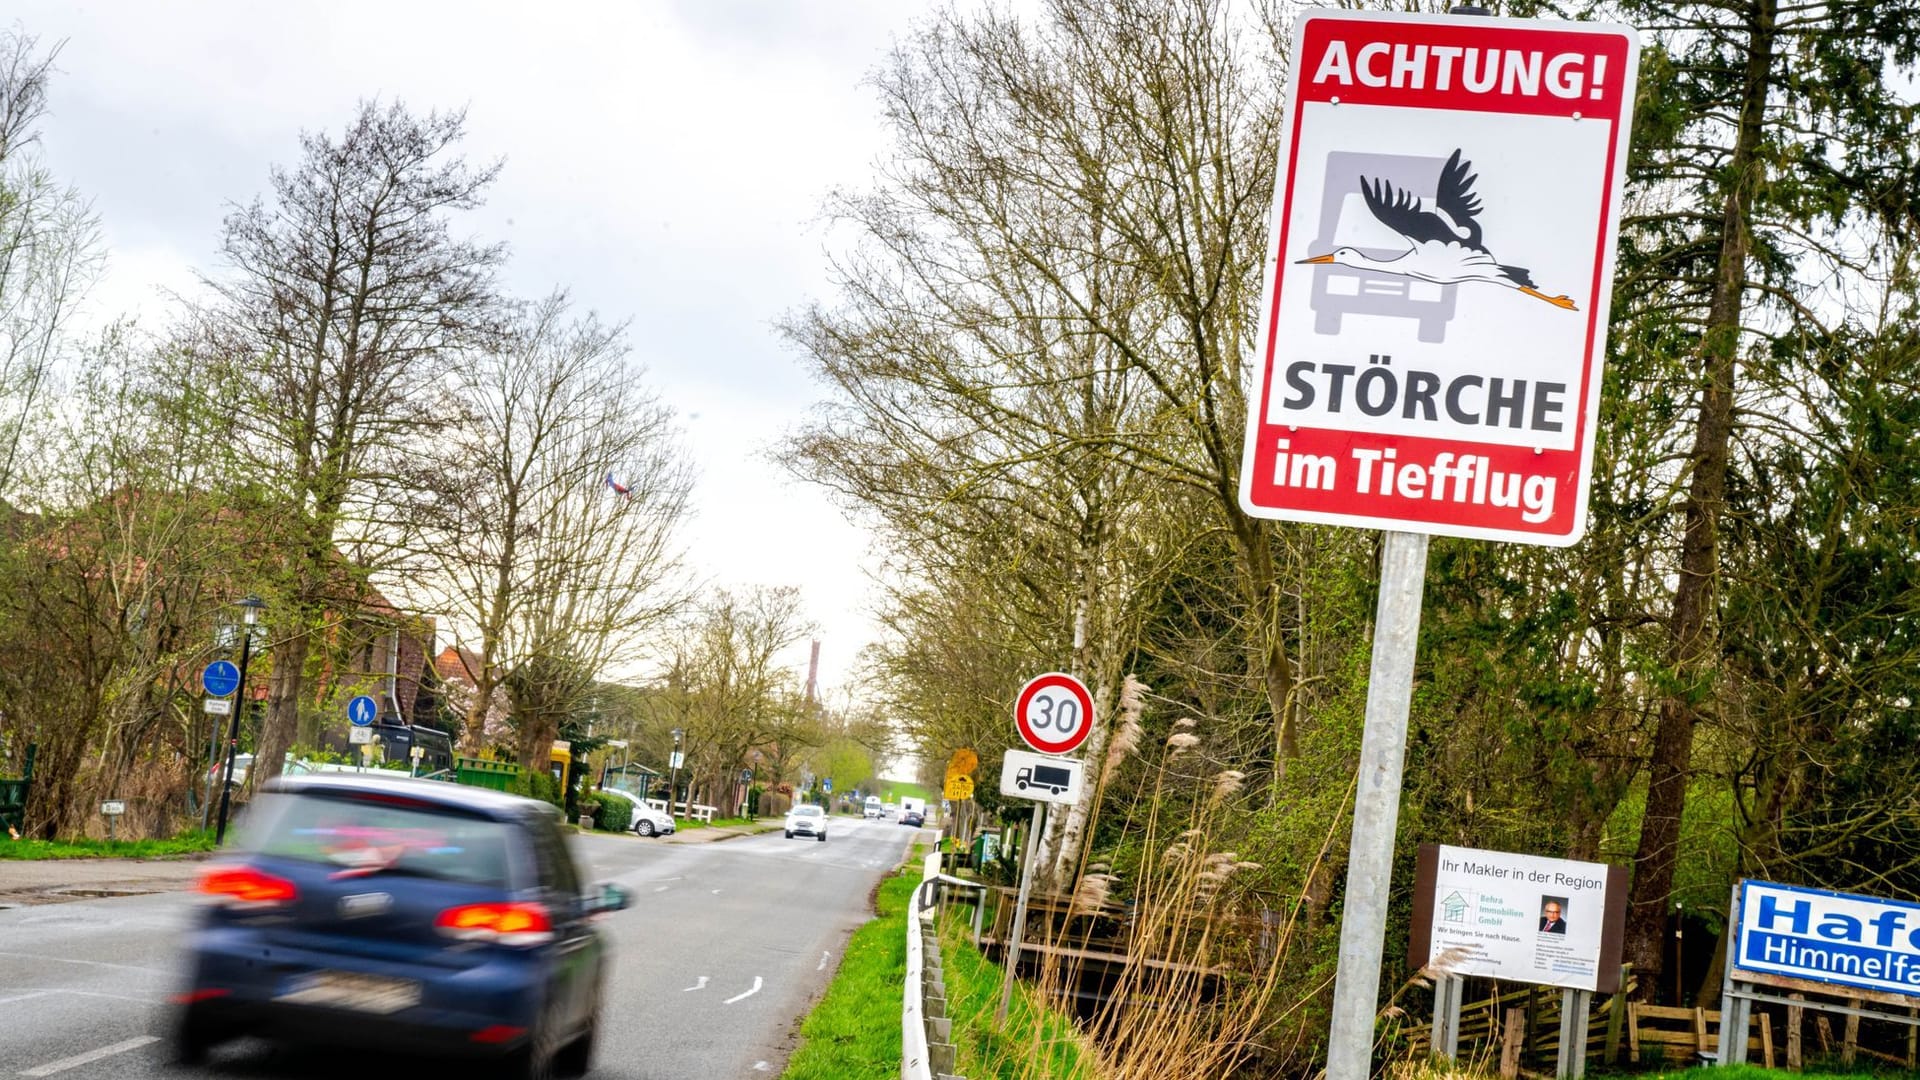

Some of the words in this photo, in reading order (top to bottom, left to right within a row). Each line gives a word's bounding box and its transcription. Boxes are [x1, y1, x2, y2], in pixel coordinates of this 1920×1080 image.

[1312, 40, 1608, 100] ACHTUNG!
[1282, 354, 1566, 432] STÖRCHE
[1272, 440, 1337, 491] im
[1353, 449, 1557, 523] Tiefflug
[1032, 695, 1077, 733] 30
[1441, 859, 1460, 873] Ihr
[1463, 862, 1509, 879] Makler
[1512, 867, 1524, 880] in
[1528, 870, 1551, 884] der
[1554, 873, 1602, 890] Region
[1478, 916, 1503, 926] GmbH
[1479, 906, 1524, 918] Immobilien
[1758, 895, 1920, 951] Haf
[1449, 928, 1473, 937] bringen
